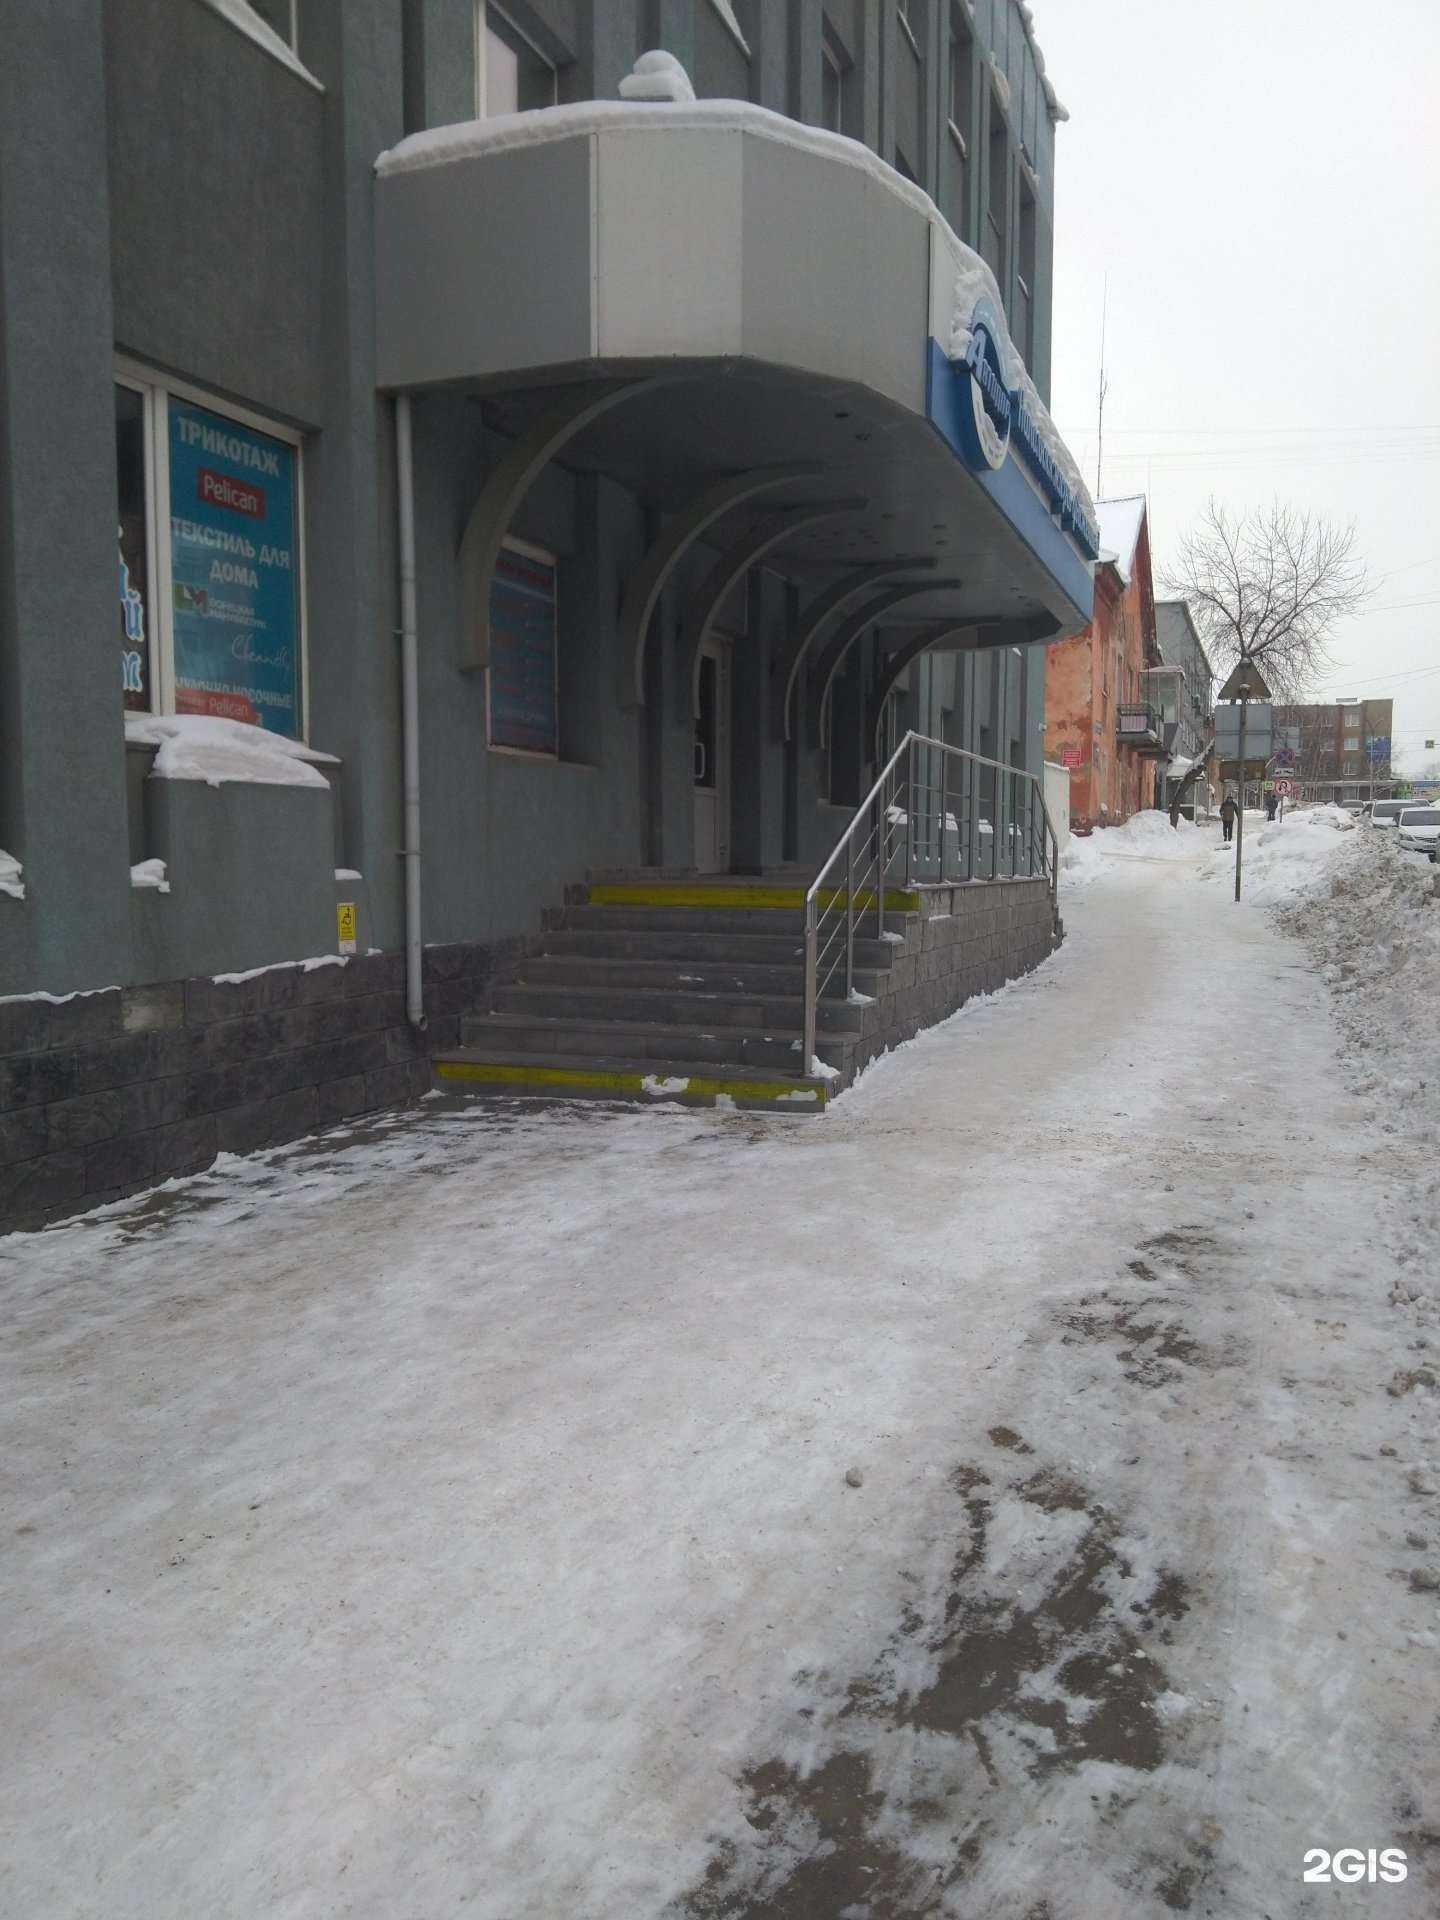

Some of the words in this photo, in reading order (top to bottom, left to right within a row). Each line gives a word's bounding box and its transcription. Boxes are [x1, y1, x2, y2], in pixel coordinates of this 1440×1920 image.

[176, 415, 280, 478] ТРИКОТАЖ
[203, 474, 257, 512] Pelican
[171, 516, 256, 559] ТЕКСТИЛЬ
[258, 543, 290, 569] ДЛЯ
[209, 559, 259, 590] ДОМА
[208, 697, 249, 722] Pelican
